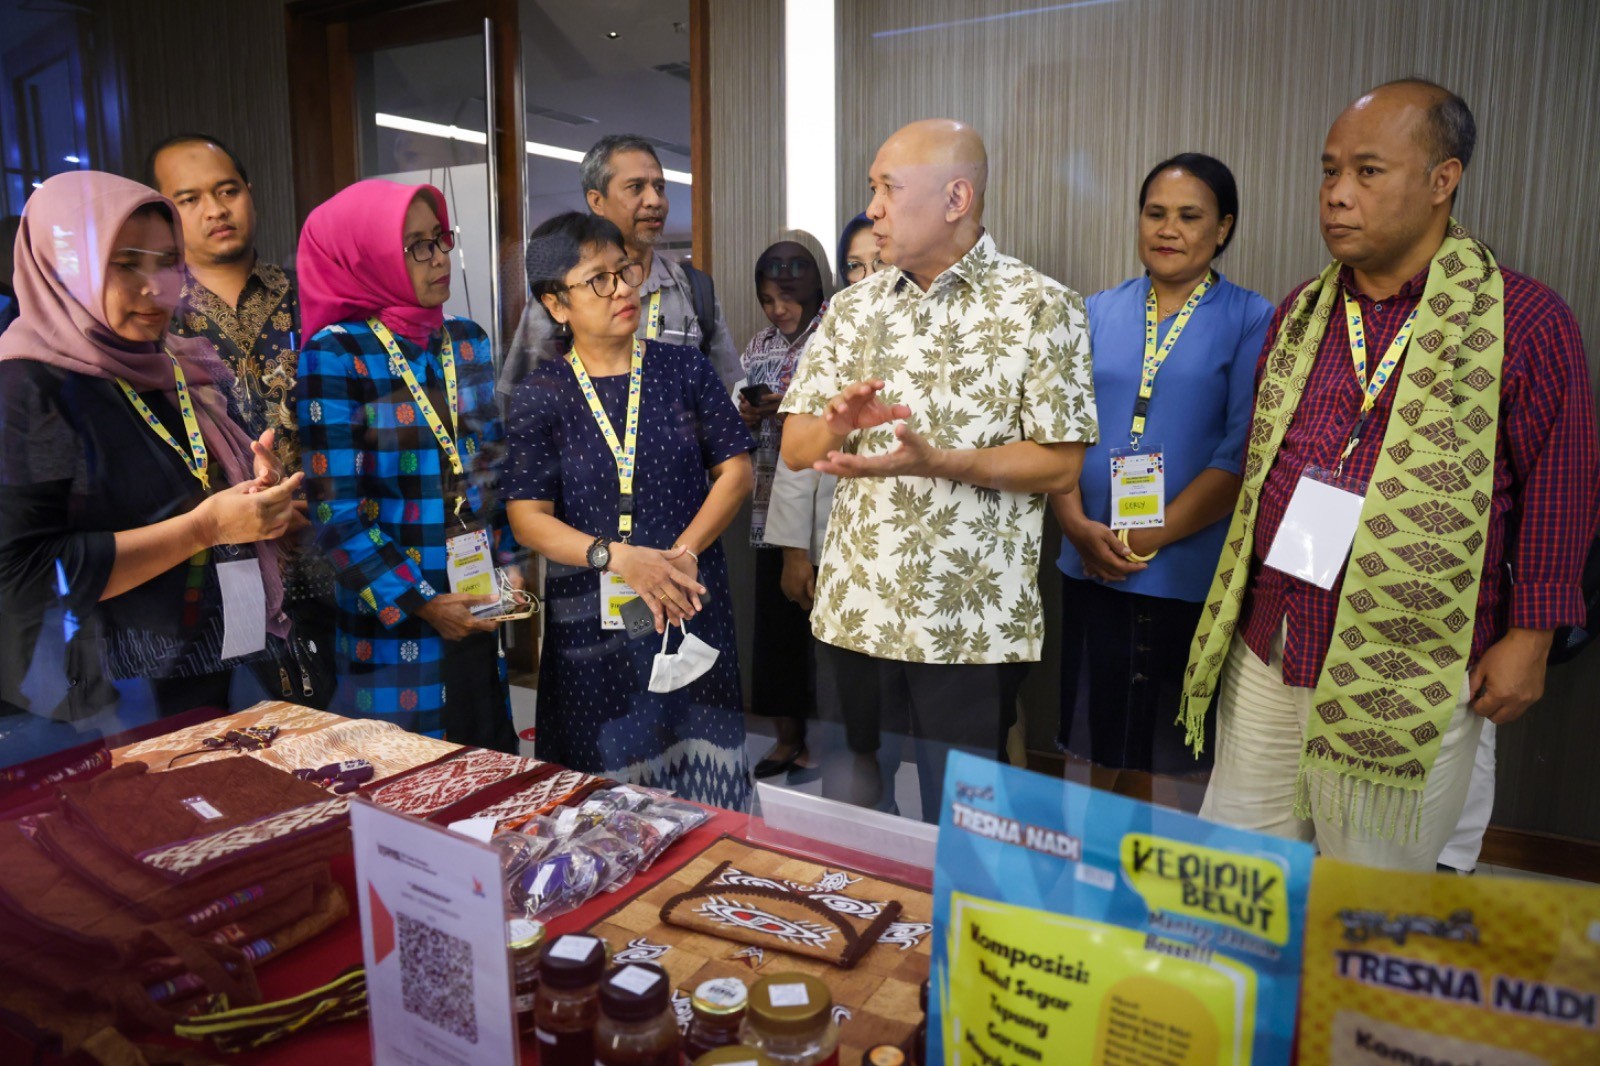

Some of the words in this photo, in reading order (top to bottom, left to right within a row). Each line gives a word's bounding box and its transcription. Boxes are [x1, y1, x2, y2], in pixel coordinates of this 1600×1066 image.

[952, 802, 1021, 845] TRESNA
[1026, 825, 1079, 859] NADI
[1181, 879, 1272, 931] BELUT
[1335, 950, 1481, 1003] TRESNA
[1494, 977, 1597, 1026] NADI
